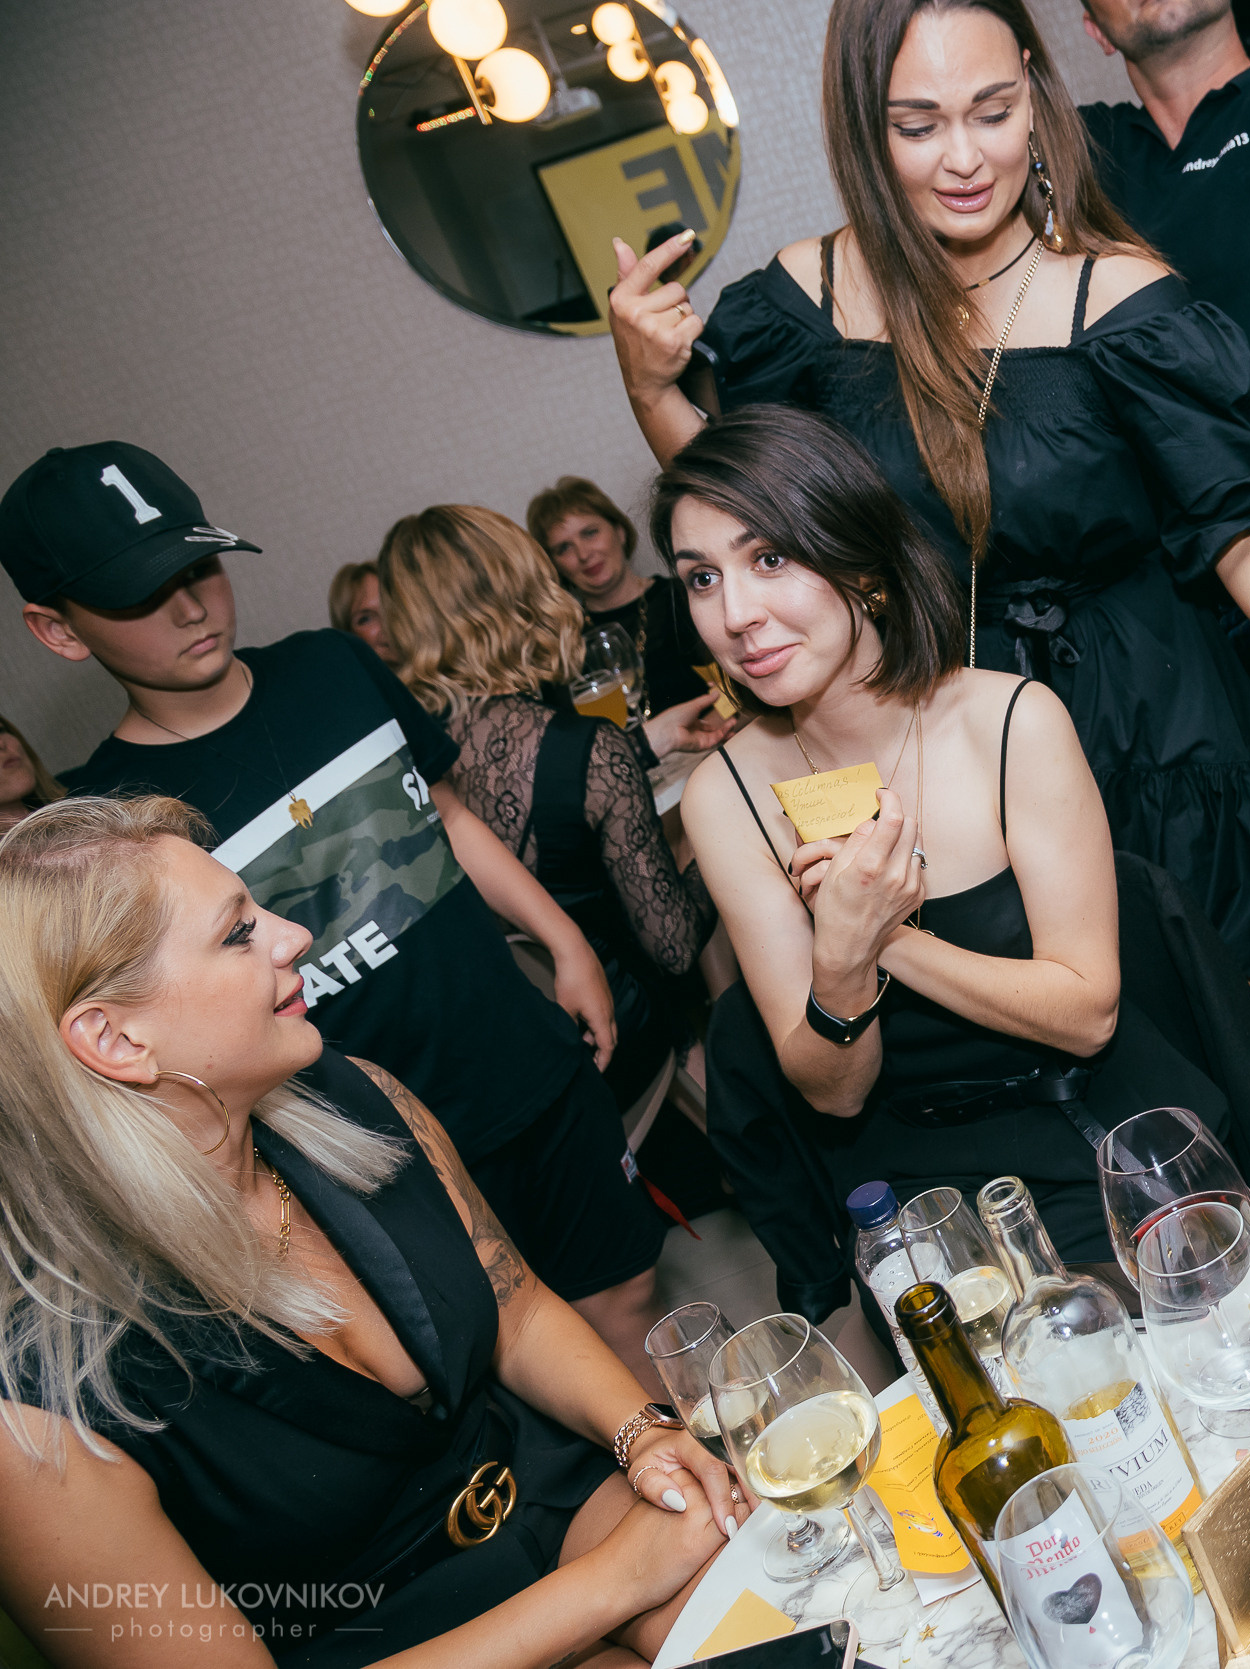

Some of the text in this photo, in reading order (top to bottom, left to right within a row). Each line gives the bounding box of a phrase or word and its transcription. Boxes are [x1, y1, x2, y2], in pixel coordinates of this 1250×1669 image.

[101, 463, 162, 524] 1
[299, 920, 399, 1009] ATE
[1087, 1426, 1119, 1445] 2020
